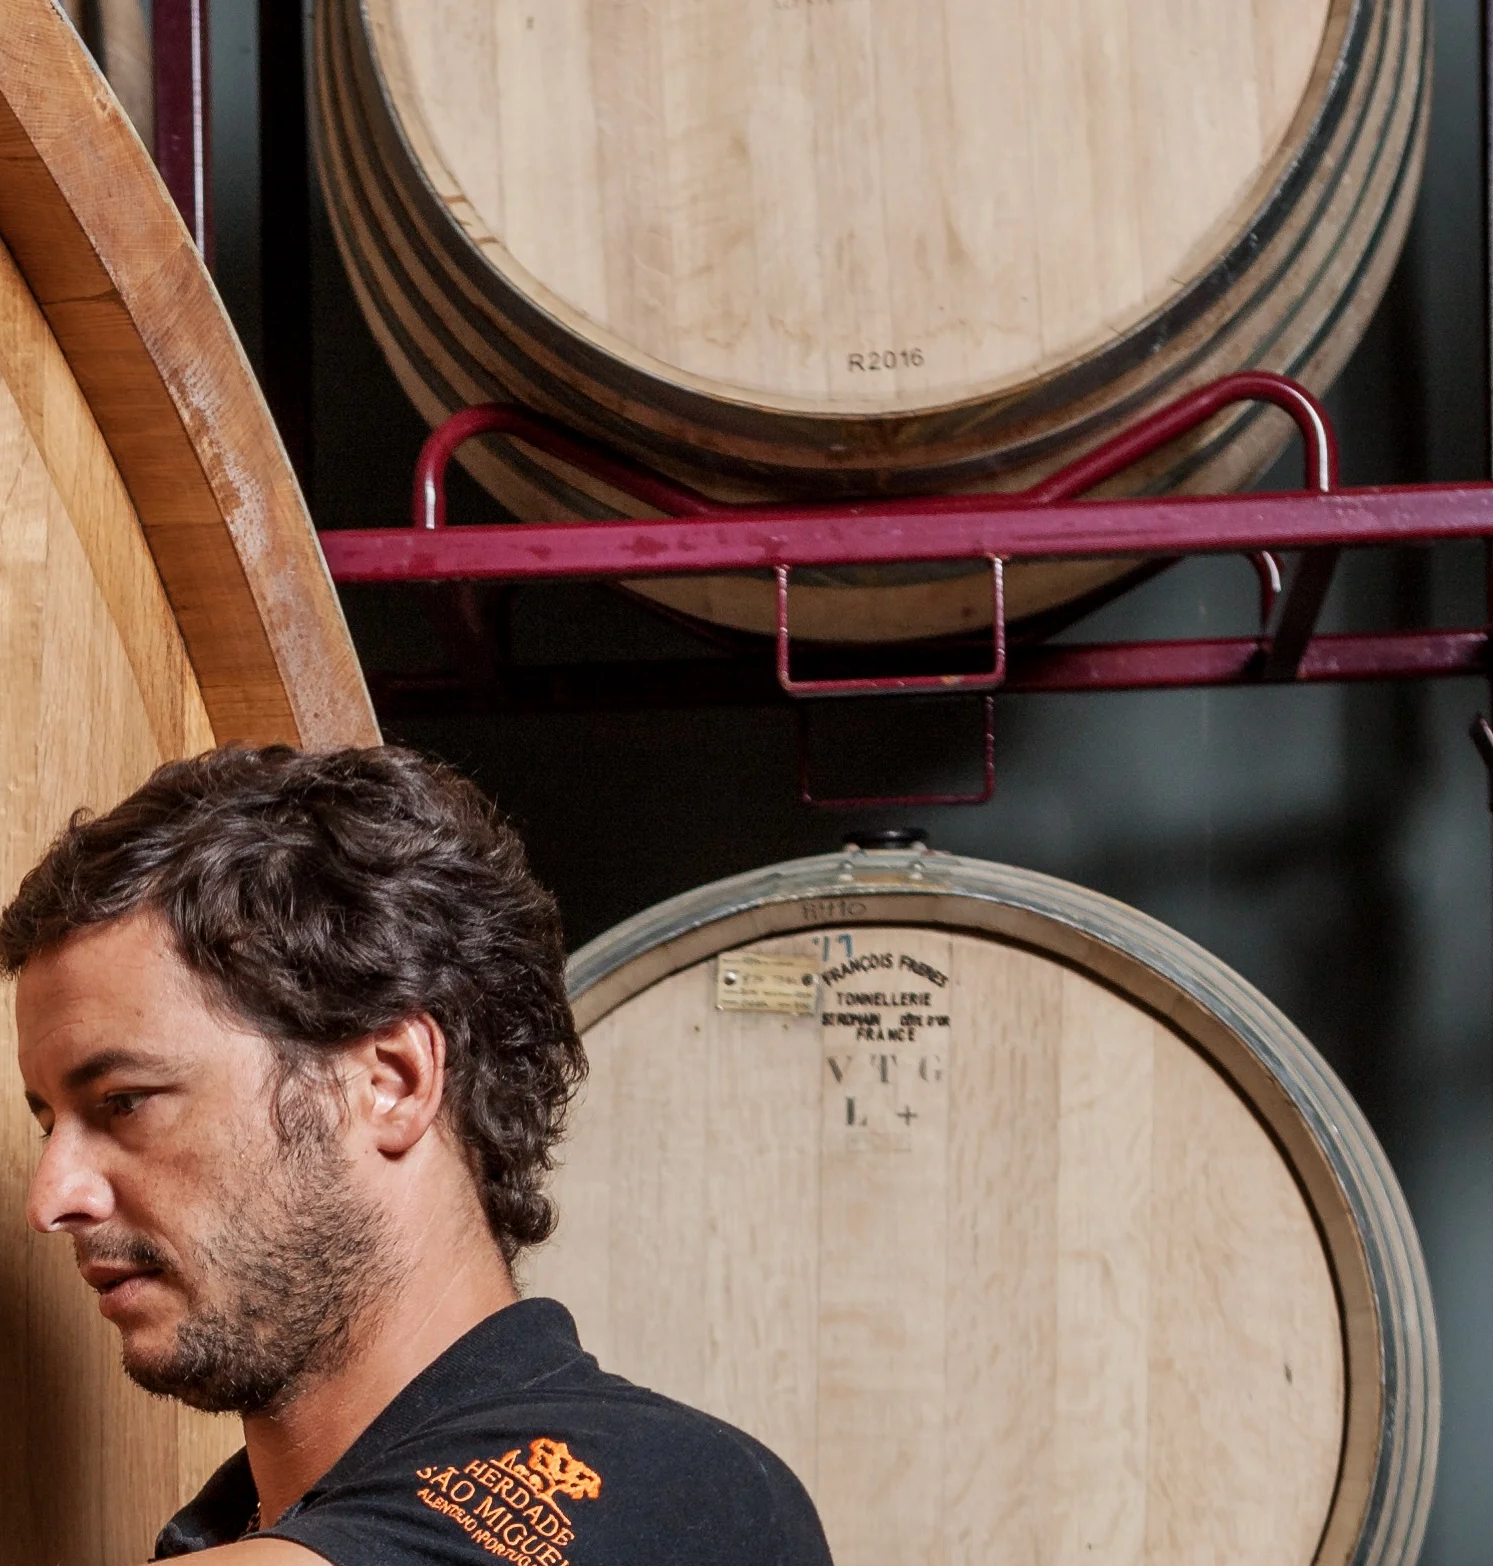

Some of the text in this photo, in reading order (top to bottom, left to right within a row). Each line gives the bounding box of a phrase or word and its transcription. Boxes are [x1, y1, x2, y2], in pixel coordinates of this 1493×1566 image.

[821, 952, 893, 987] FRANÇOIS
[836, 991, 932, 1007] TONNELLERIE
[856, 1026, 916, 1042] FRANCE
[416, 1466, 476, 1502] SÃO
[416, 1488, 478, 1532] ALENTEJO
[464, 1459, 576, 1546] HERDADE
